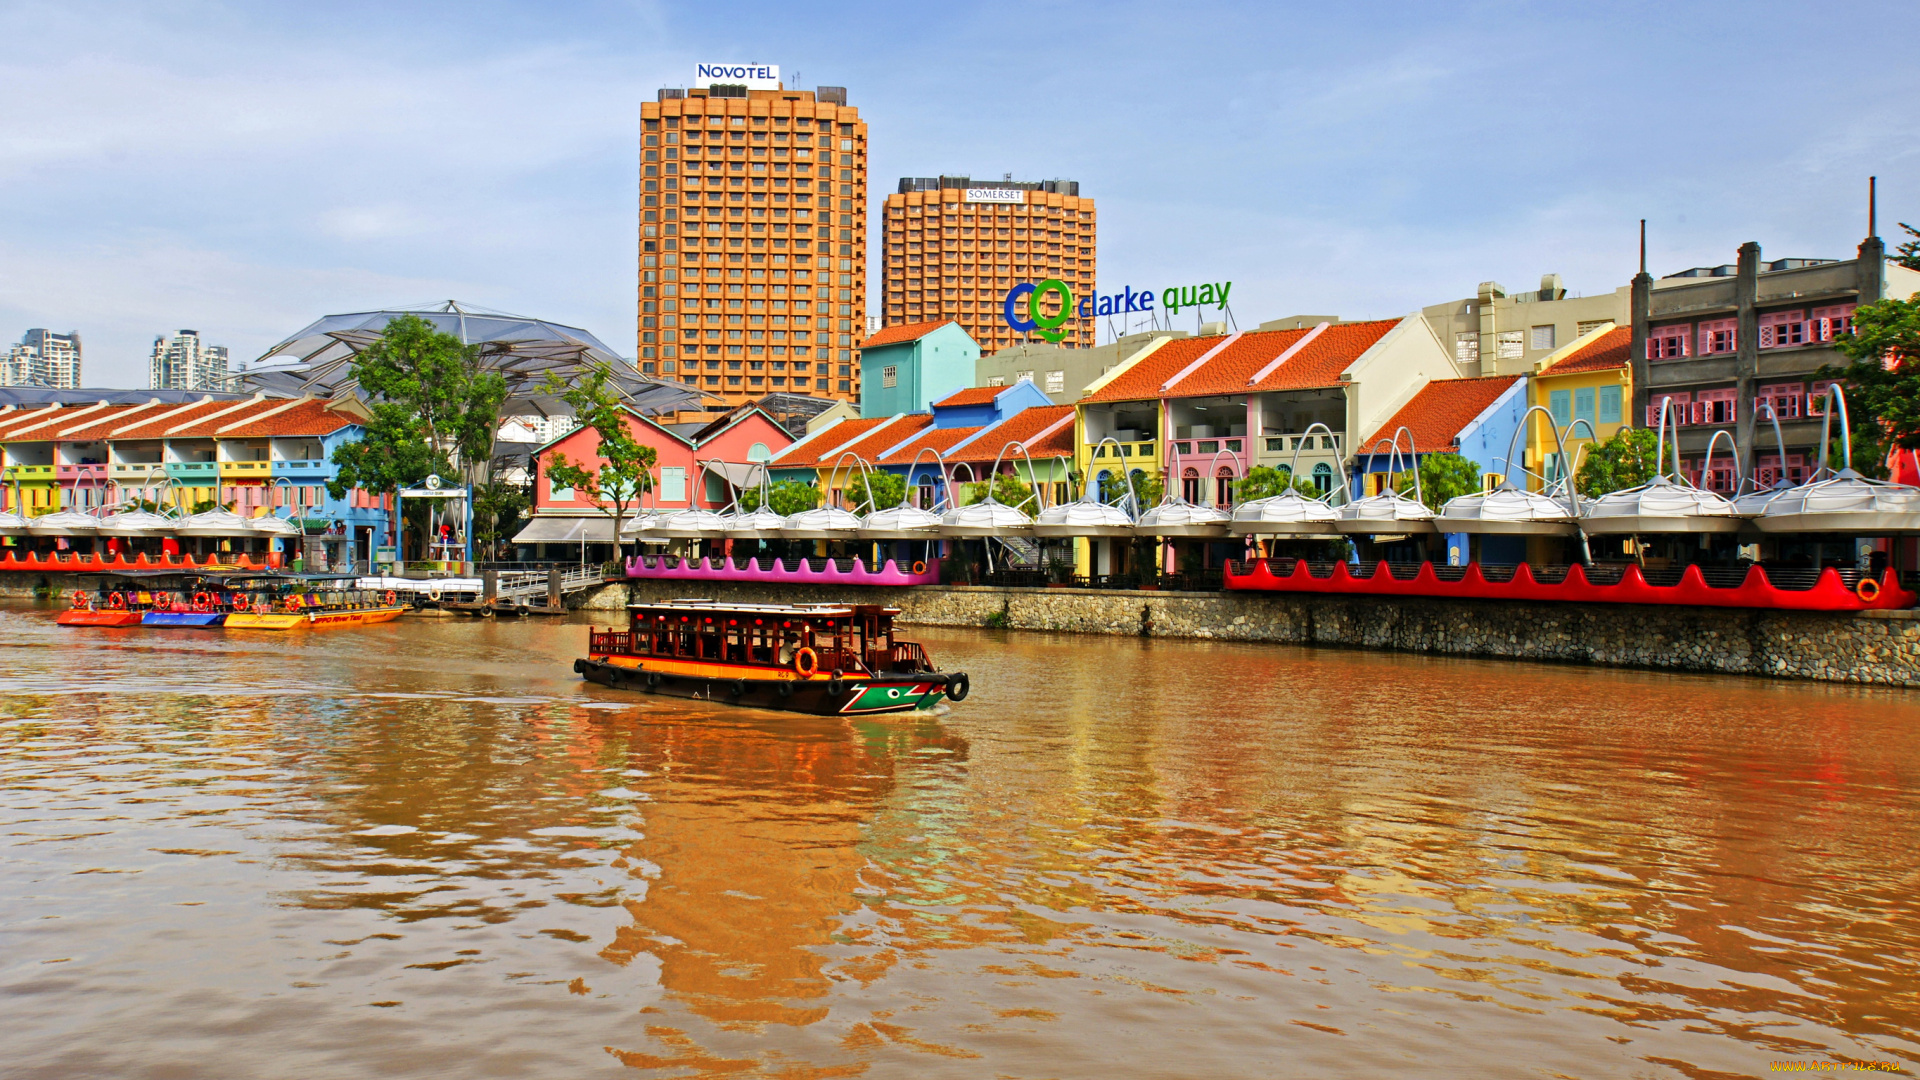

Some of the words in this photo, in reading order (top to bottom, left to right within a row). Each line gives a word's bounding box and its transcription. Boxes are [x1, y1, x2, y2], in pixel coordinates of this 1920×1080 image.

[698, 64, 776, 79] NOVOTEL
[968, 189, 1021, 199] SOMERSET
[1078, 285, 1155, 318] clarke
[1162, 281, 1232, 315] quay
[805, 625, 810, 633] 9
